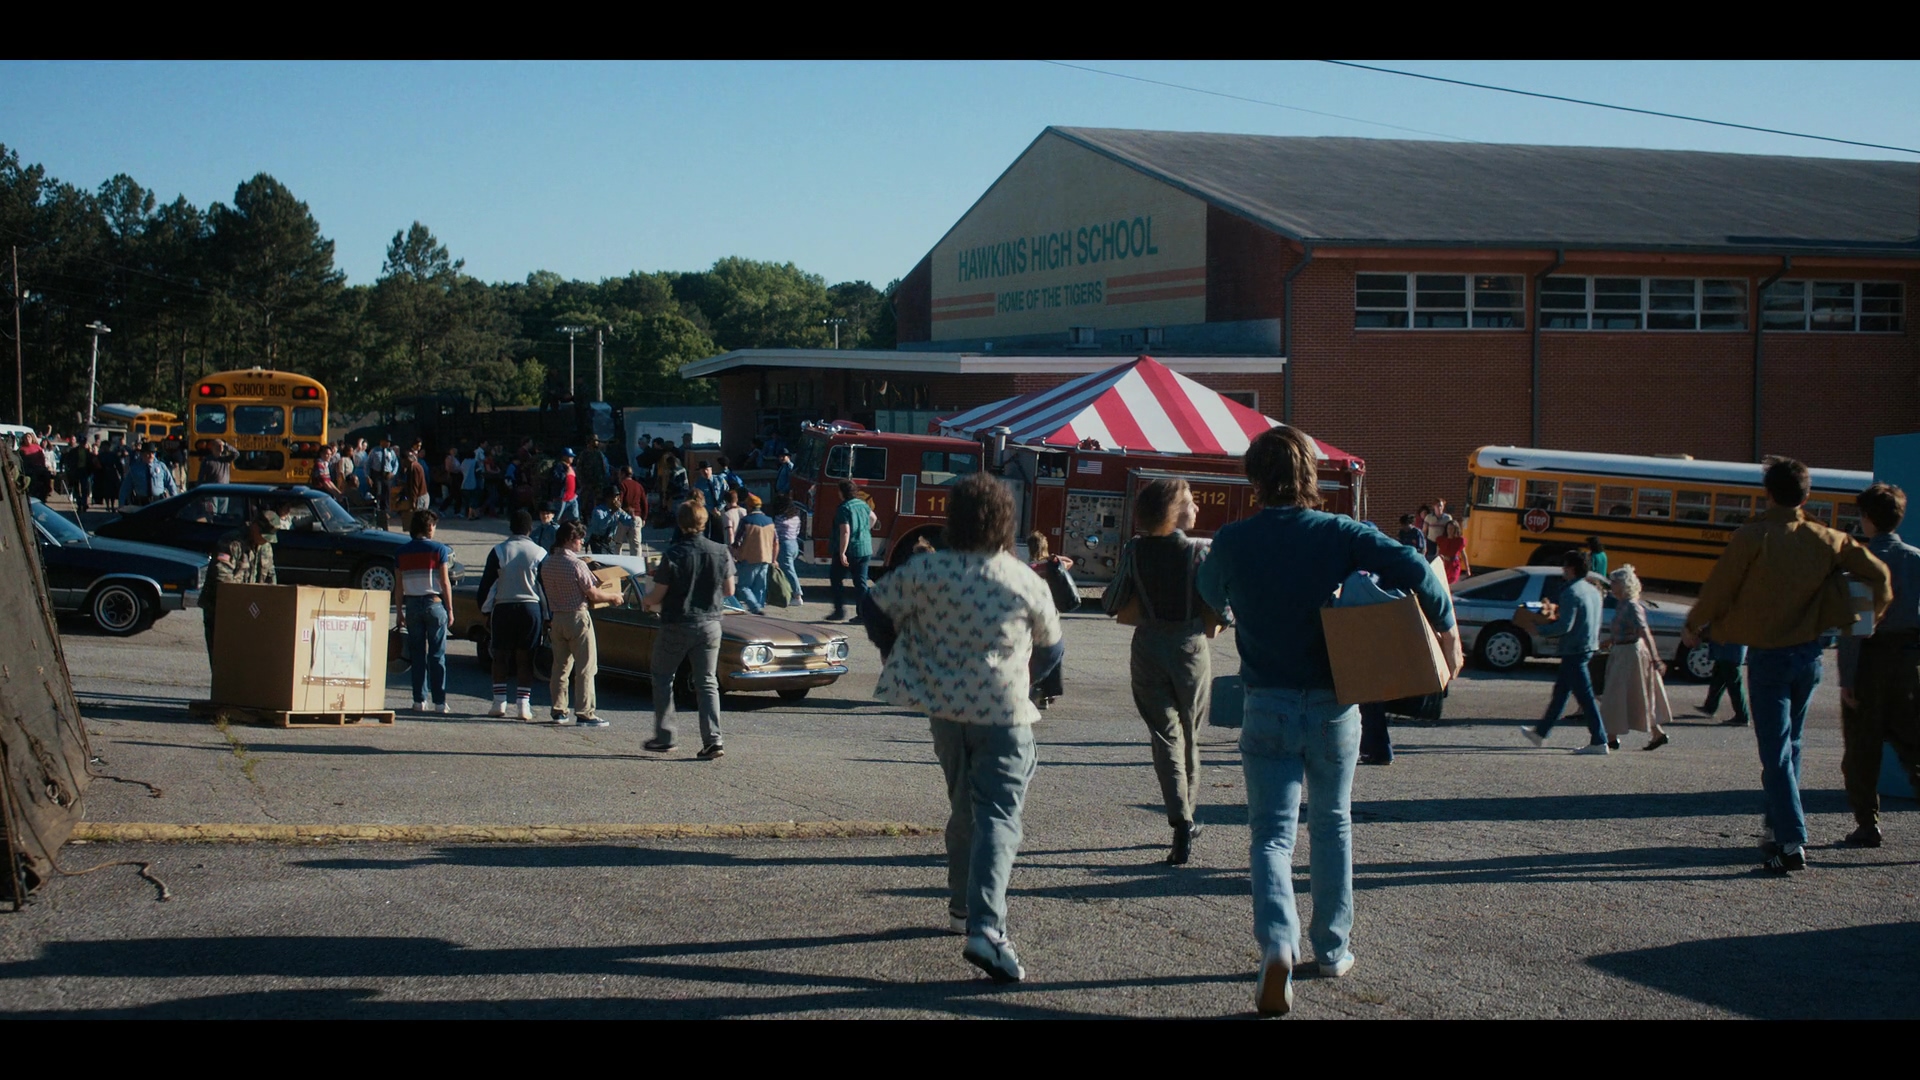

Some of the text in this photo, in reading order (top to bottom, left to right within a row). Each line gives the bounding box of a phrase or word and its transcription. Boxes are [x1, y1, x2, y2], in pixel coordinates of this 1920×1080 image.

[958, 216, 1158, 282] HAWKINS HIGH SCHOOL
[998, 280, 1102, 313] HOME OF THE TIGERS
[233, 383, 286, 397] SCHOOL BUS
[928, 496, 948, 511] 11
[1528, 516, 1547, 526] STOP
[320, 620, 367, 631] RELIEF AID
